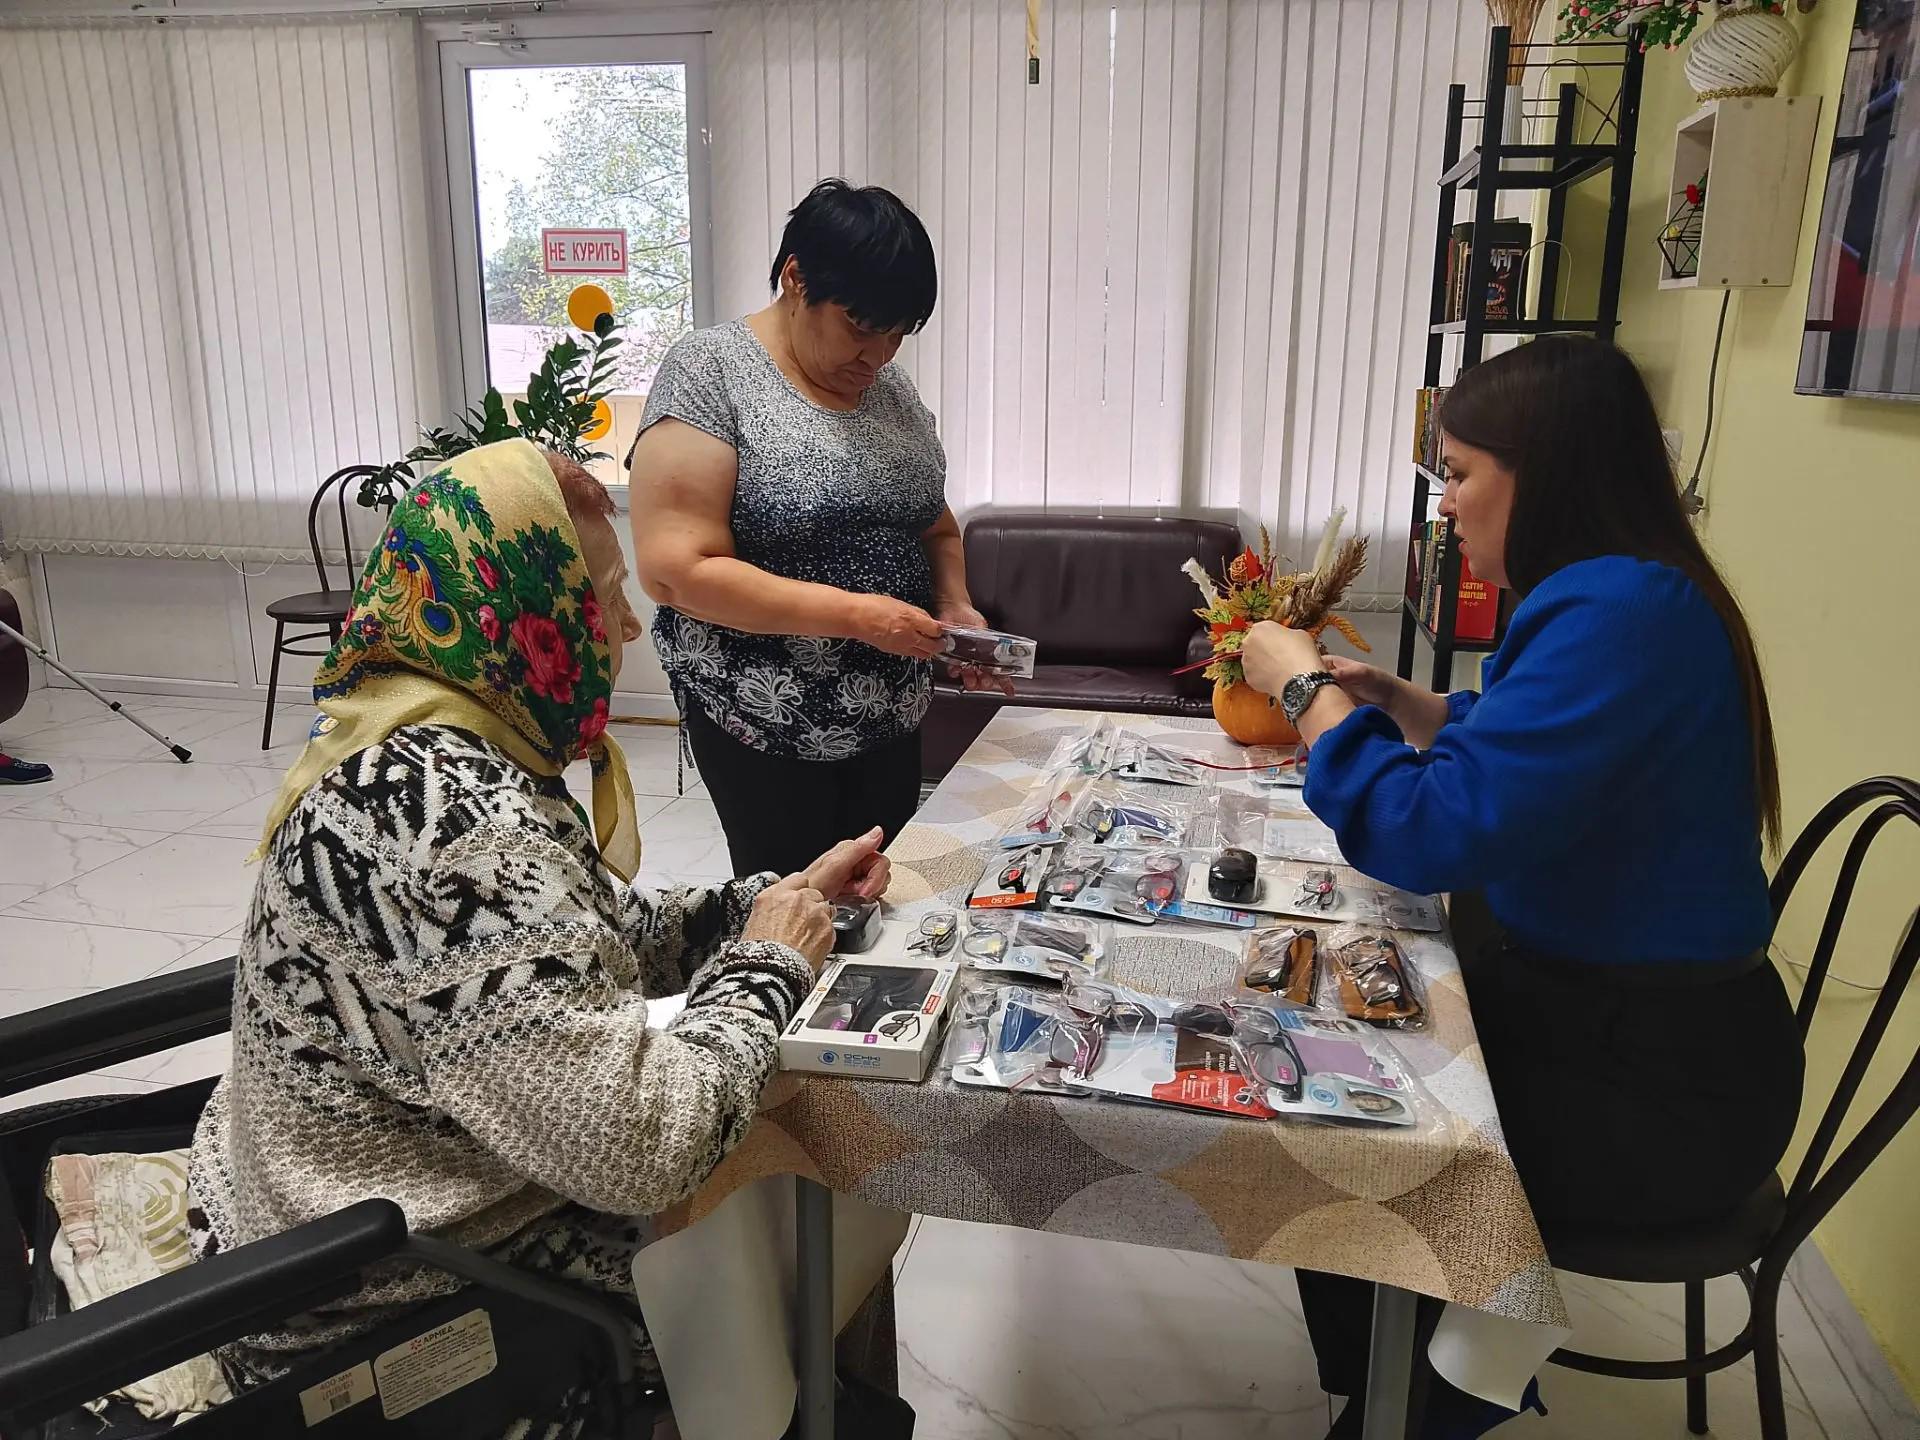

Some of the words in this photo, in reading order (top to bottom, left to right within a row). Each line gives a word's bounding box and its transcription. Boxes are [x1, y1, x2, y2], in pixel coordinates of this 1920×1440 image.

[549, 242, 566, 262] НЕ
[573, 242, 620, 262] КУРИТЬ
[423, 1325, 454, 1344] АРМЕД
